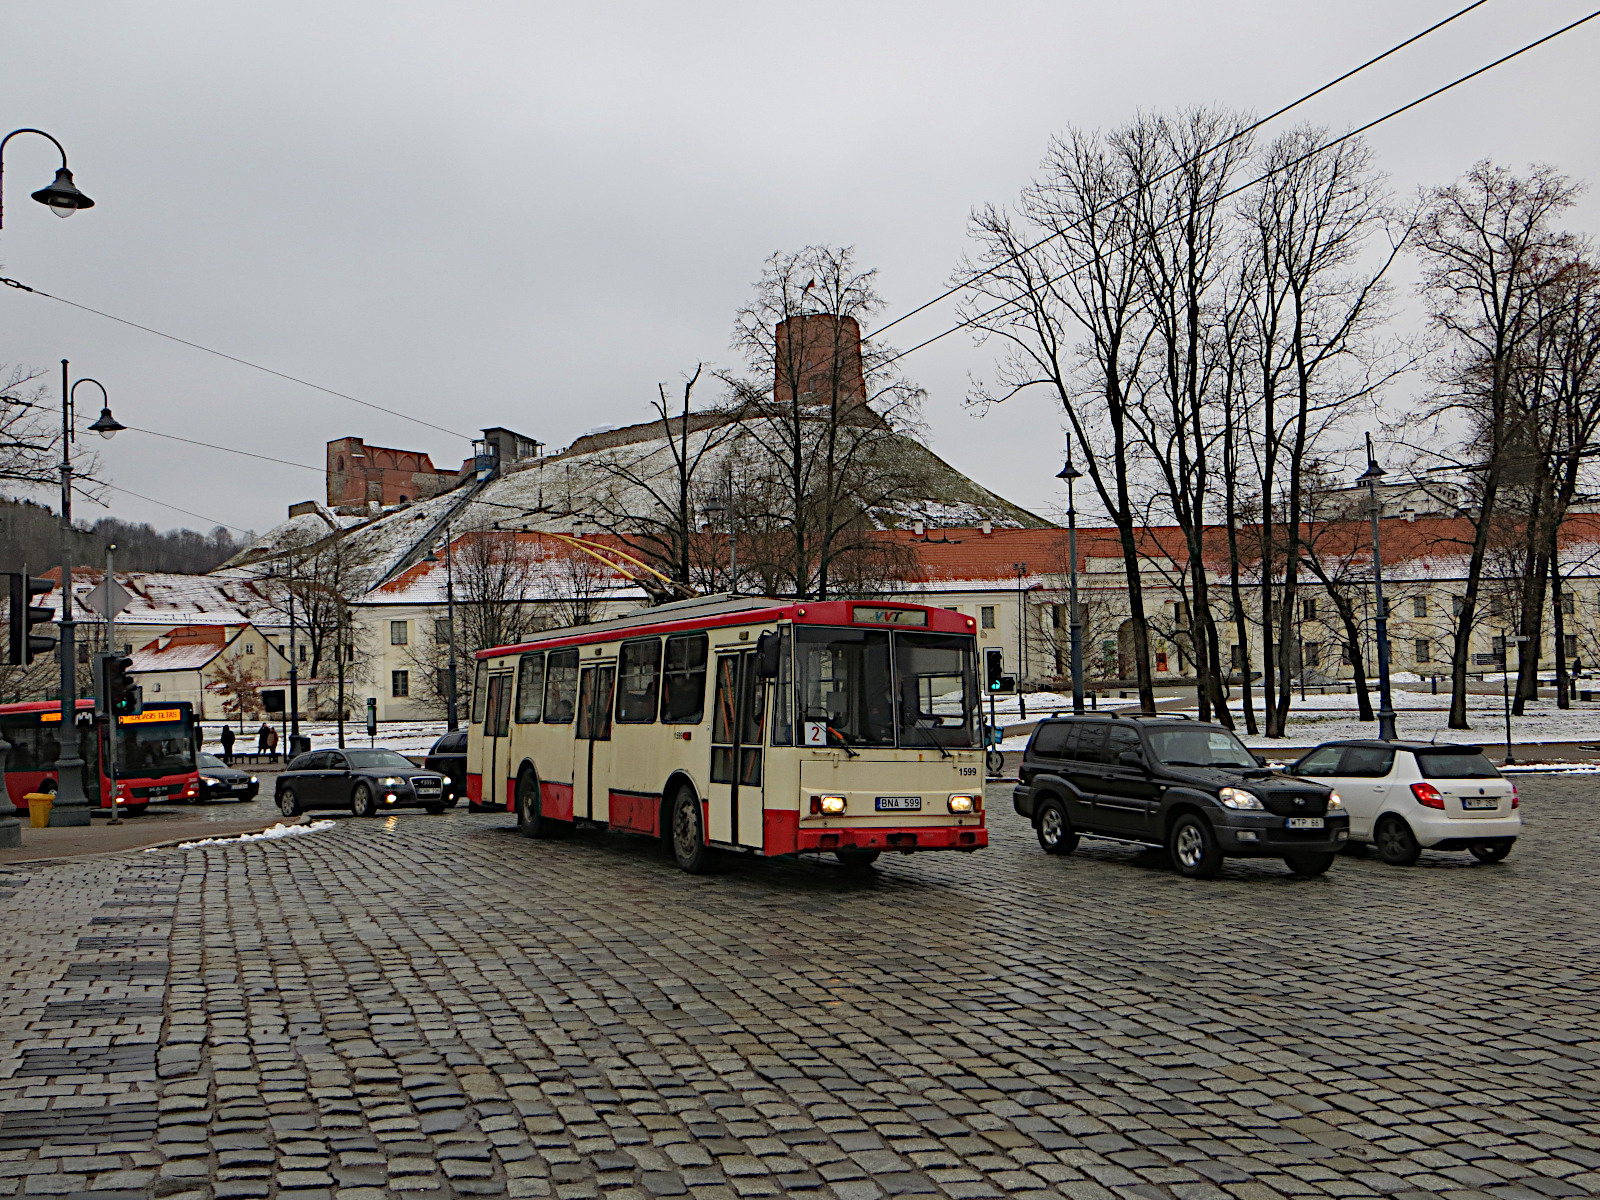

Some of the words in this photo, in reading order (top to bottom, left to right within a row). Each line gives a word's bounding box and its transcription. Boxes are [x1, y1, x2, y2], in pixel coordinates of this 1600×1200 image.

[874, 611, 903, 623] VVT
[811, 726, 820, 741] 2
[958, 767, 977, 776] 1599
[881, 798, 899, 808] BNA
[904, 798, 920, 808] 599
